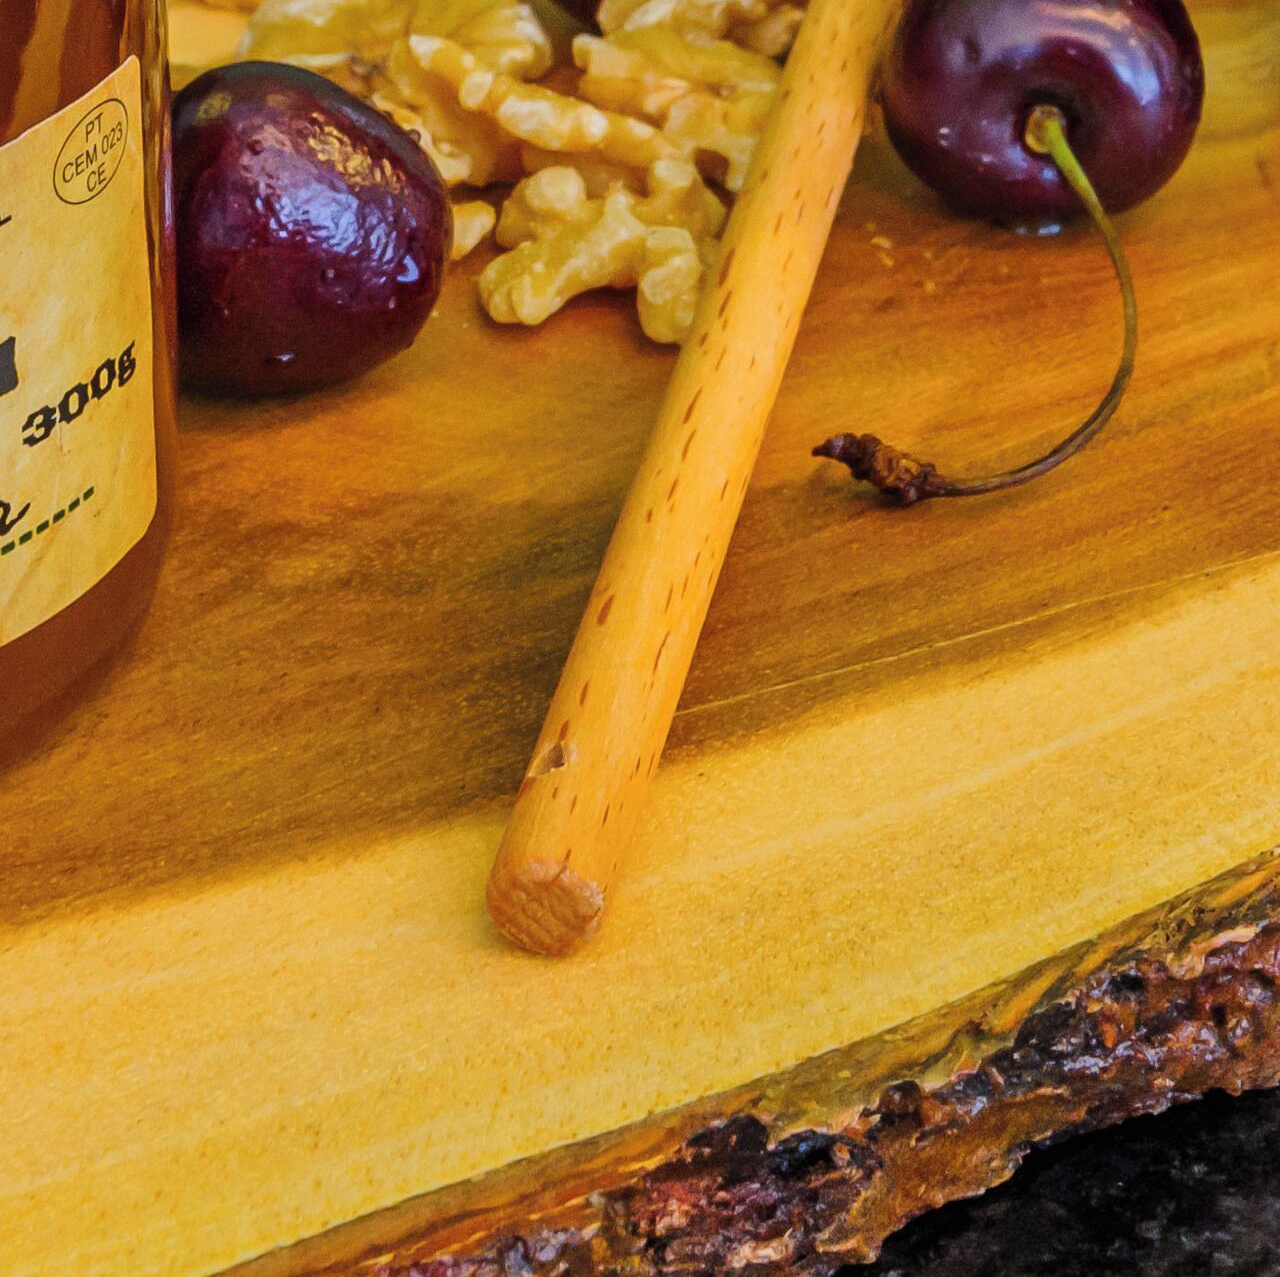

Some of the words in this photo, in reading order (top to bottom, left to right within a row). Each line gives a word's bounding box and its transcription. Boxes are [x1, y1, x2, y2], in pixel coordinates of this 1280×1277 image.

[84, 111, 105, 144] PT
[62, 143, 98, 183] CEM
[101, 121, 123, 156] 023
[86, 161, 107, 192] CE
[21, 338, 138, 449] 300g
